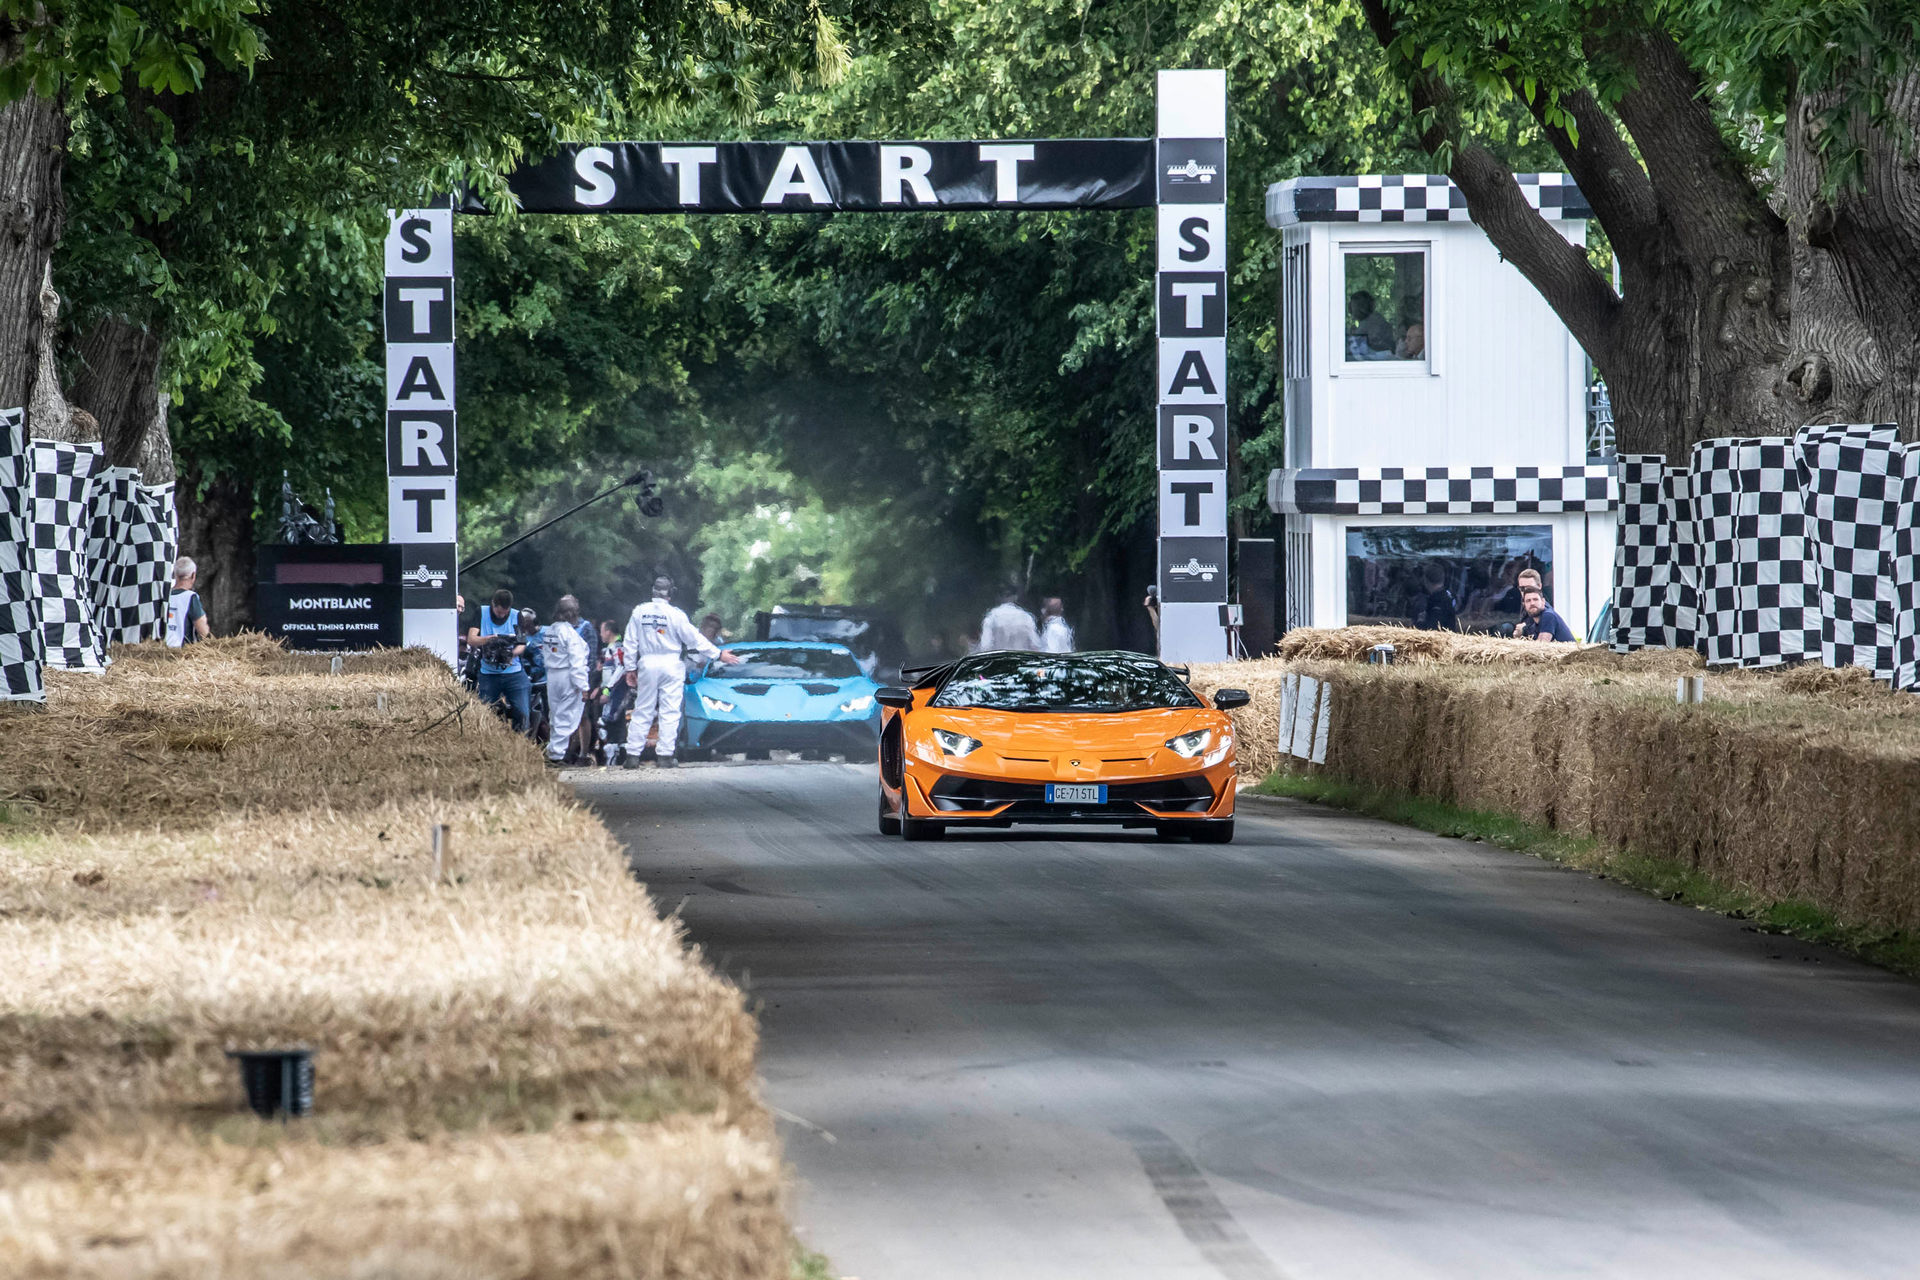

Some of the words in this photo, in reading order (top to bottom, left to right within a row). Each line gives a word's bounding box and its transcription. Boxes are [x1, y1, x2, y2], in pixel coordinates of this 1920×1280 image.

[574, 144, 1035, 206] START
[395, 218, 449, 533] START
[1167, 216, 1219, 527] START
[282, 623, 316, 631] OFFICIAL
[317, 623, 345, 631] TIMING
[289, 598, 372, 610] MONTBLANC
